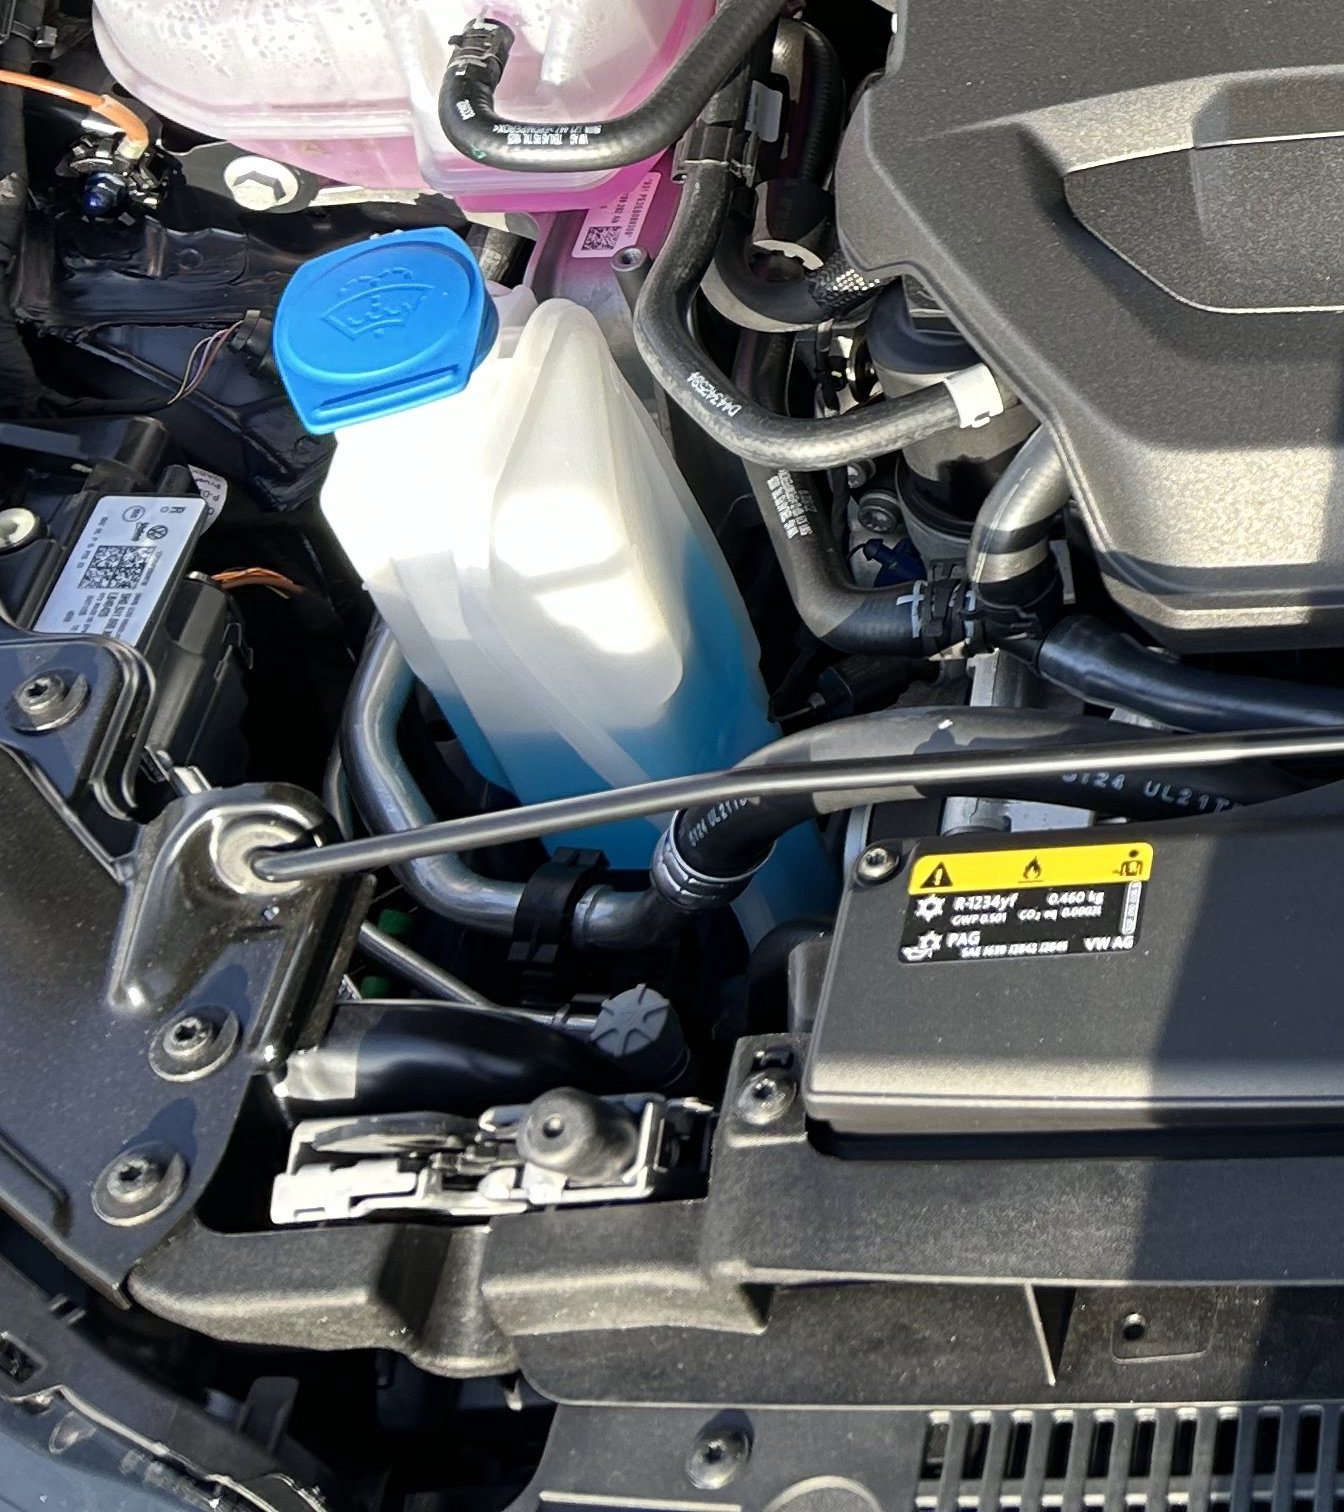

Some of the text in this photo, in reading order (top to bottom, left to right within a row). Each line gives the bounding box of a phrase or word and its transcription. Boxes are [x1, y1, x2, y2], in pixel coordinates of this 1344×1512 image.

[946, 931, 1134, 951] PAG VW AG
